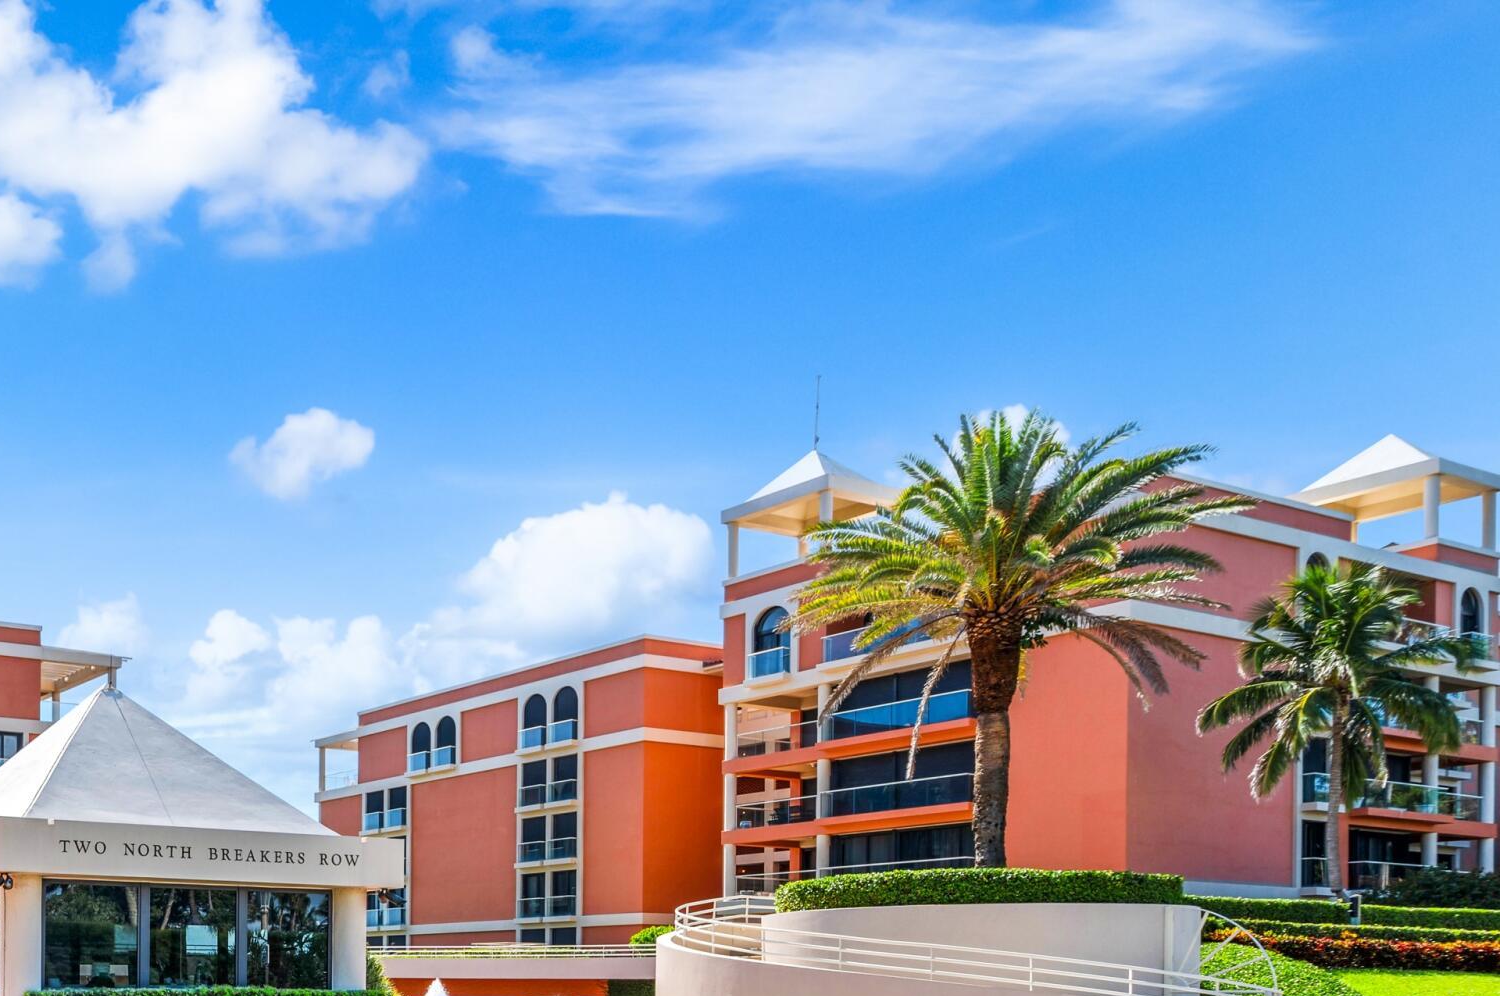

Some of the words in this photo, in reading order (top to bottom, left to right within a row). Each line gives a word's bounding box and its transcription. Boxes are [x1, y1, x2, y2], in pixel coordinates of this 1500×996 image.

[59, 840, 107, 855] TWO
[123, 843, 192, 859] NORTH
[208, 848, 305, 864] BREAKERS
[319, 853, 360, 866] ROW
